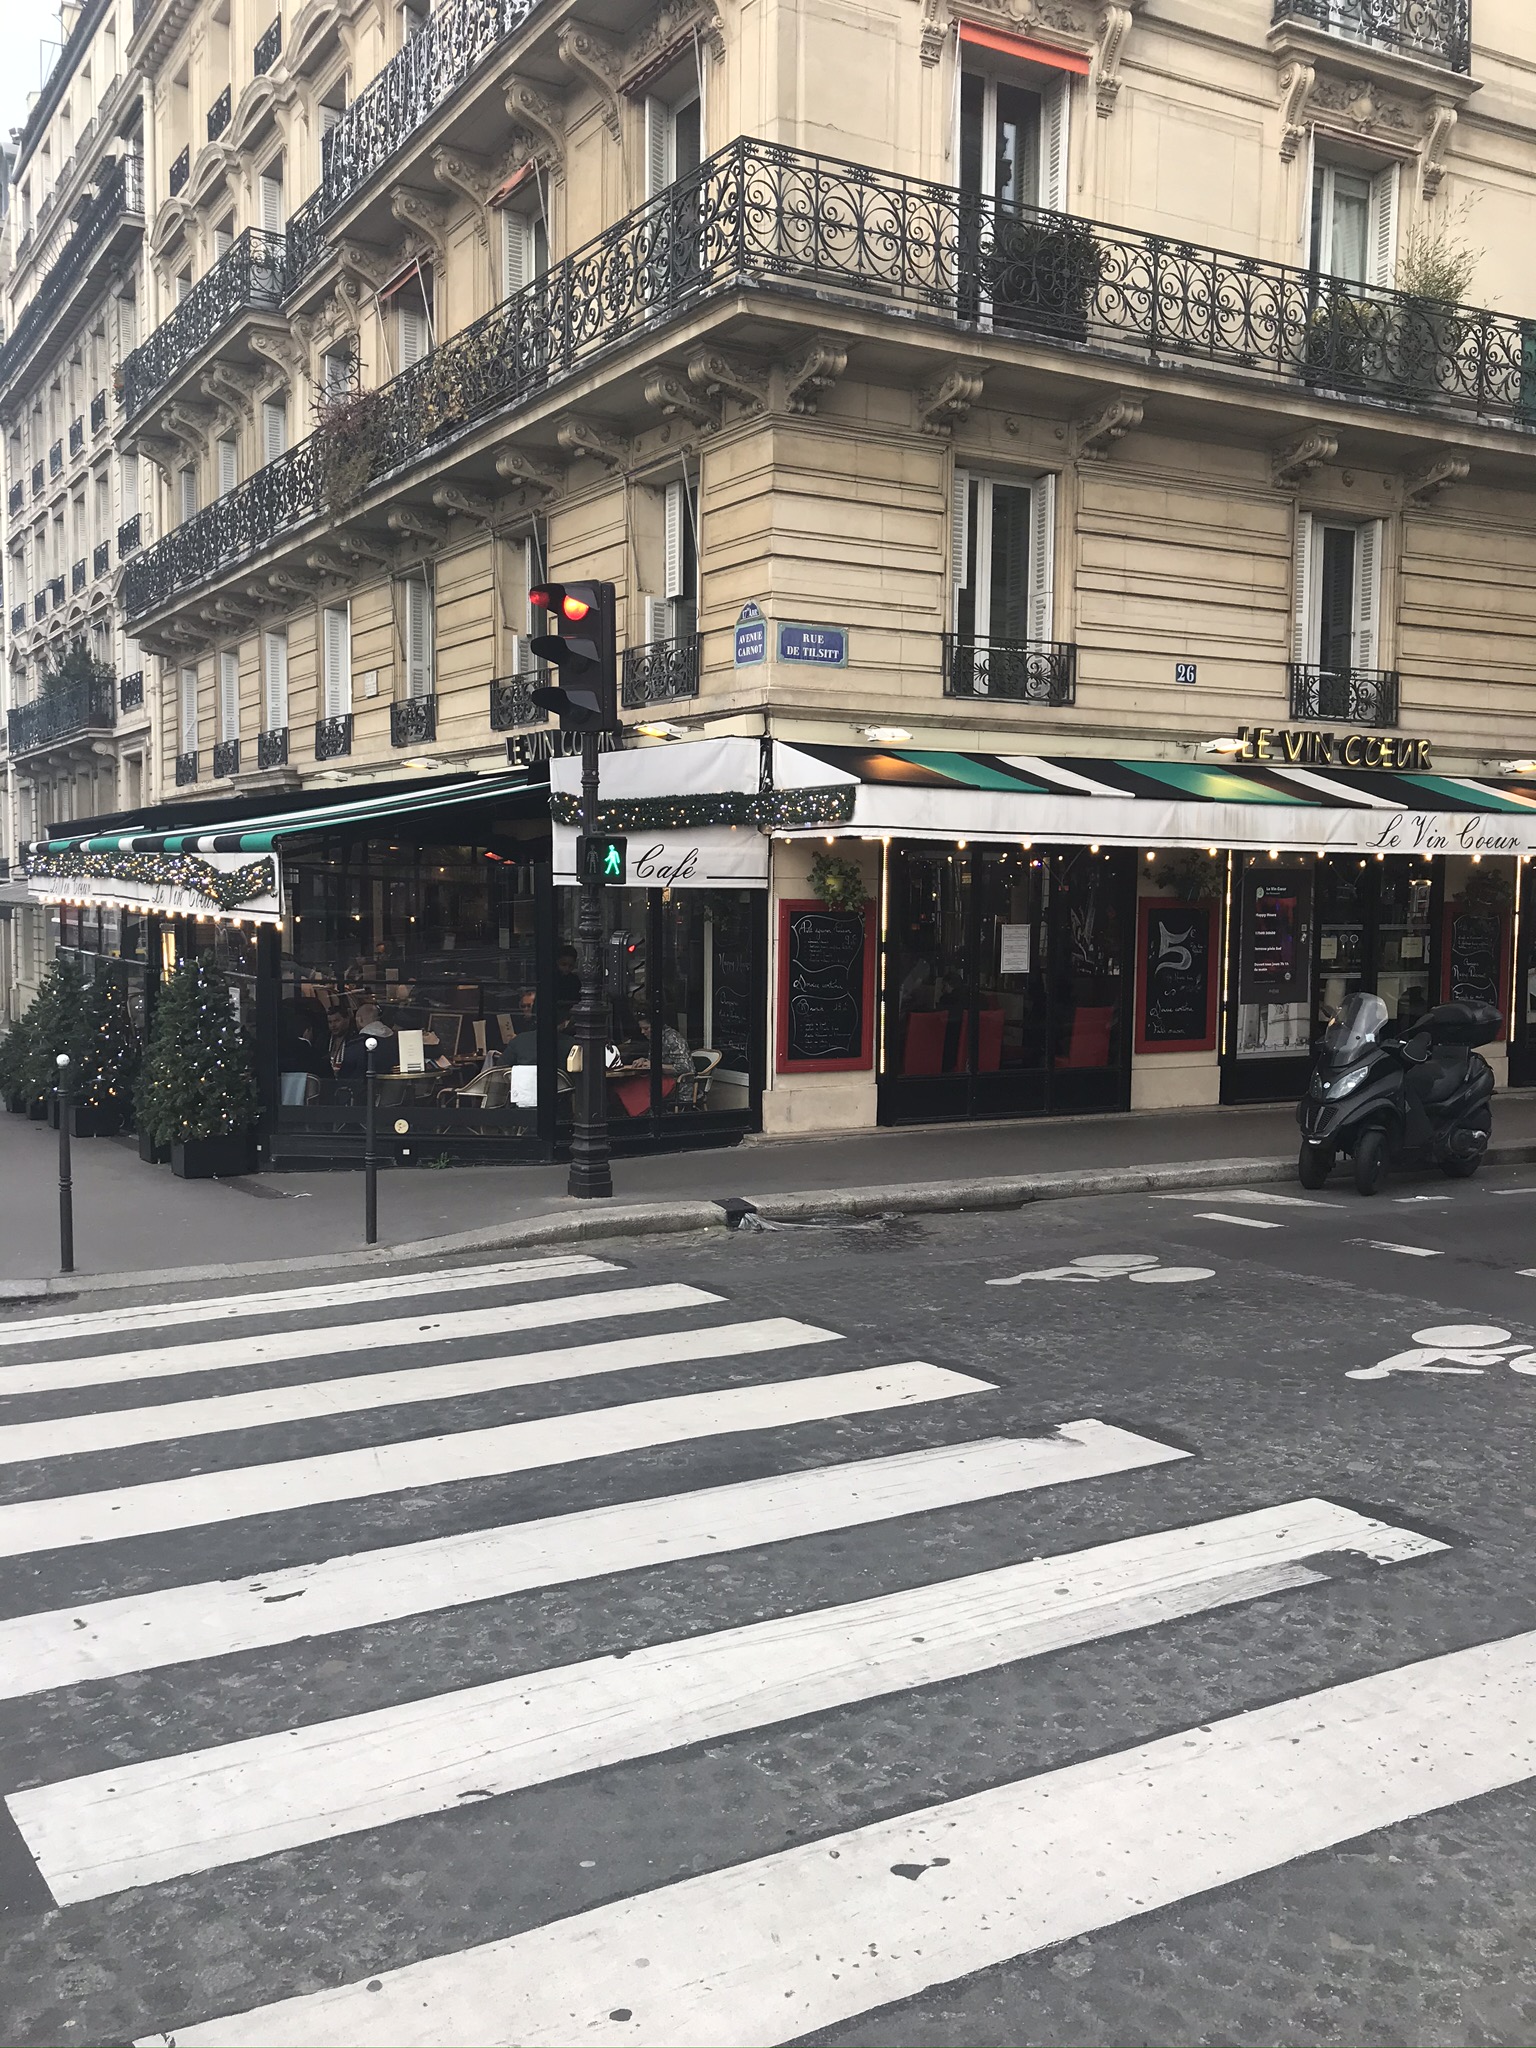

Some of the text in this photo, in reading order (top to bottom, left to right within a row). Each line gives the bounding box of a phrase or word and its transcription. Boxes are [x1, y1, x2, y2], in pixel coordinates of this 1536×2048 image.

[738, 630, 763, 645] AVENUE
[802, 633, 825, 644] RUE
[737, 644, 763, 657] CARNOT
[786, 645, 840, 659] DE TILSITT
[1177, 664, 1195, 682] 26
[526, 730, 558, 762] VIN
[1238, 726, 1275, 763] LE
[1279, 729, 1334, 765] VIN
[1366, 813, 1521, 849] Le Vin Coeur
[631, 843, 699, 888] Café
